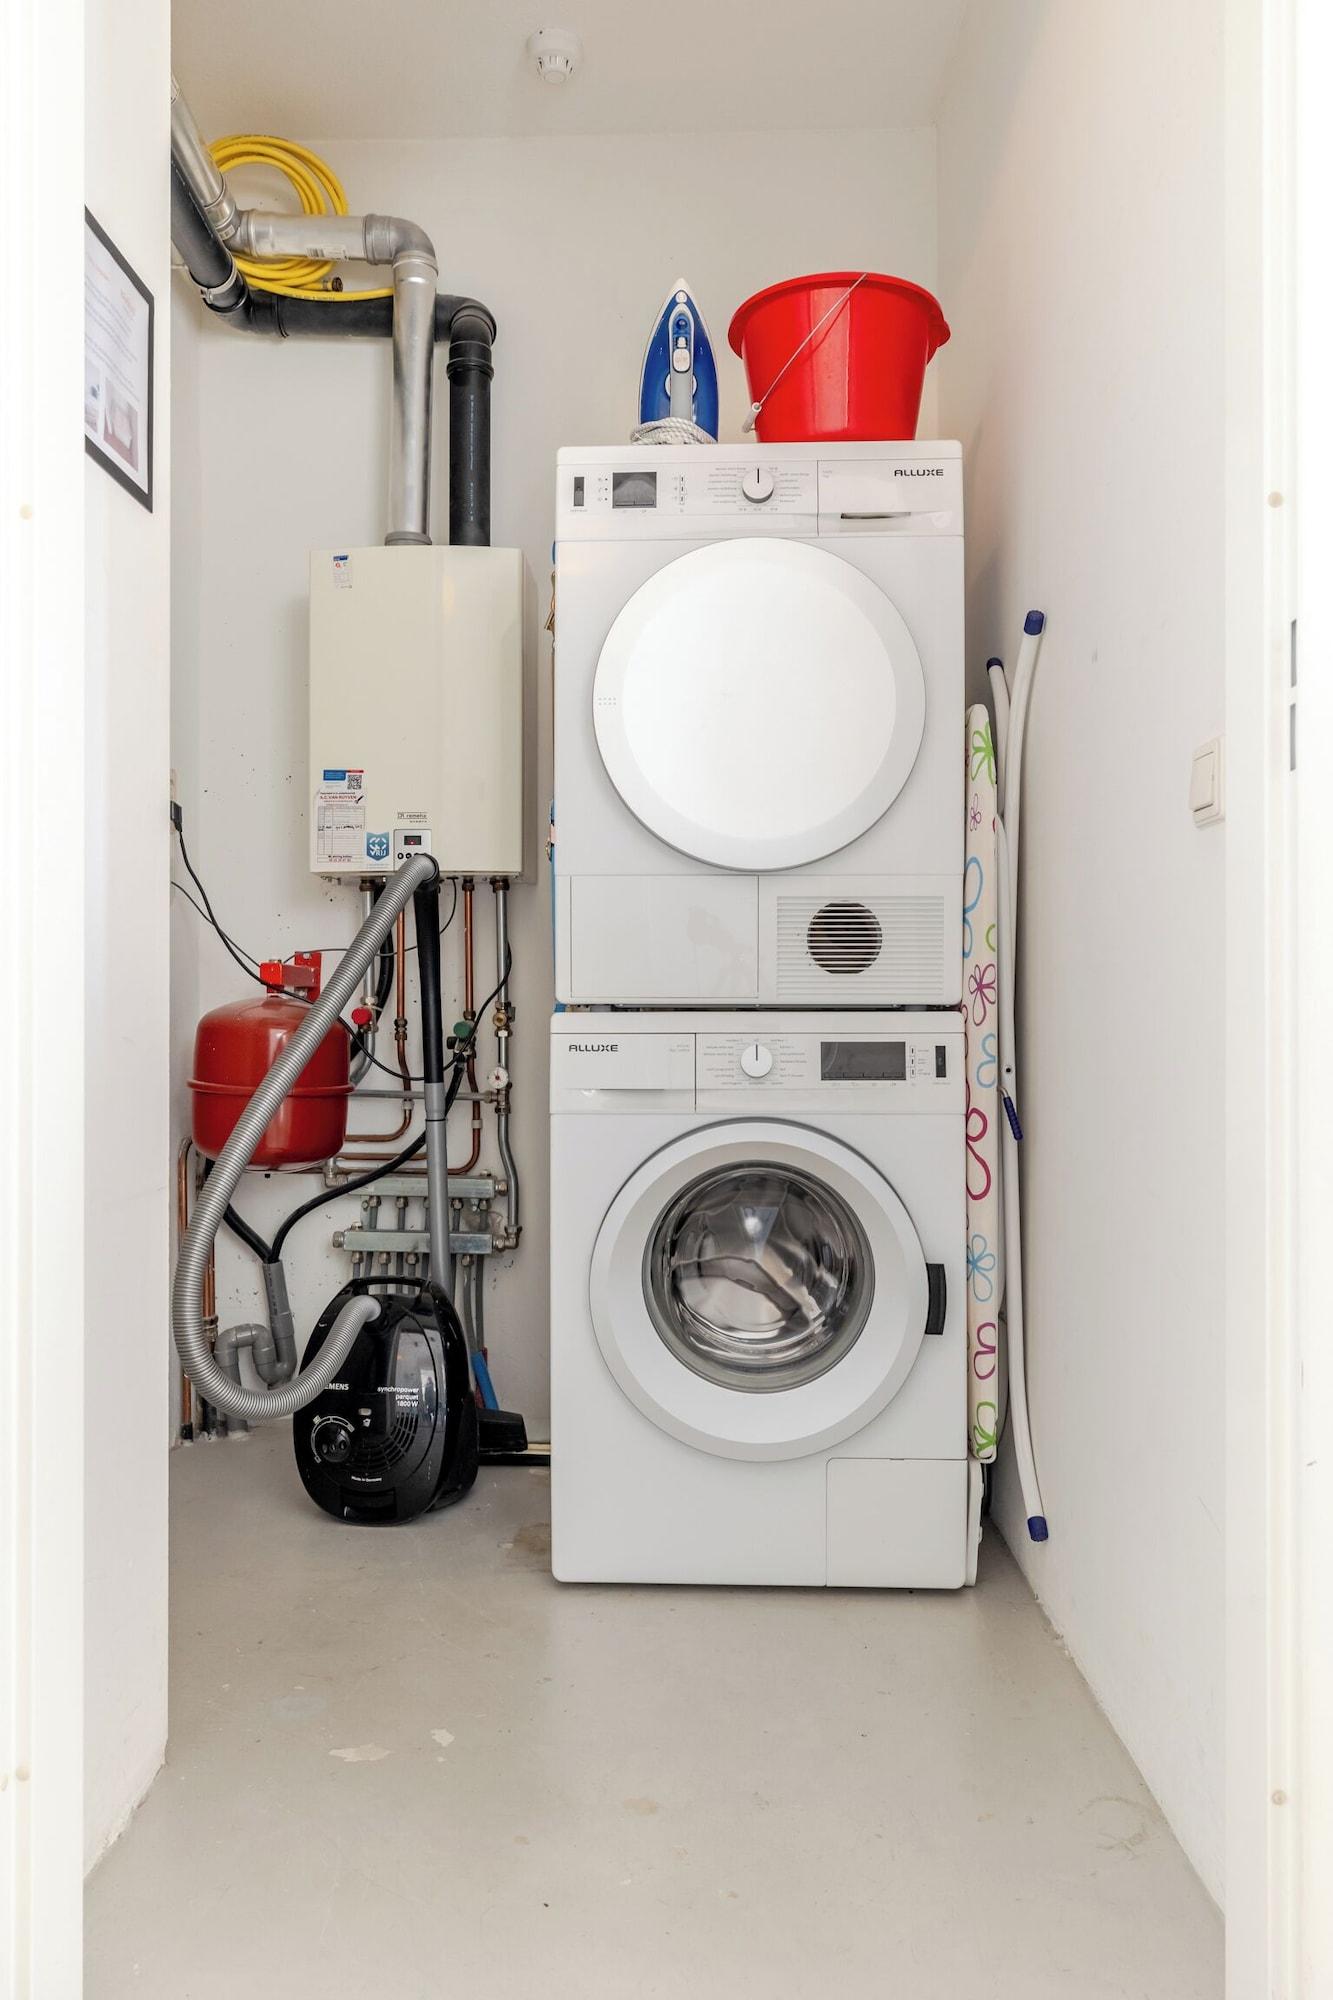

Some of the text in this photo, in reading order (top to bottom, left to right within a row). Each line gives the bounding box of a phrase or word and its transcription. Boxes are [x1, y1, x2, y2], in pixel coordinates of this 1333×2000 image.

[894, 469, 944, 477] ALLUXE
[568, 1044, 619, 1052] ALLUXE
[324, 1383, 350, 1391] MENS
